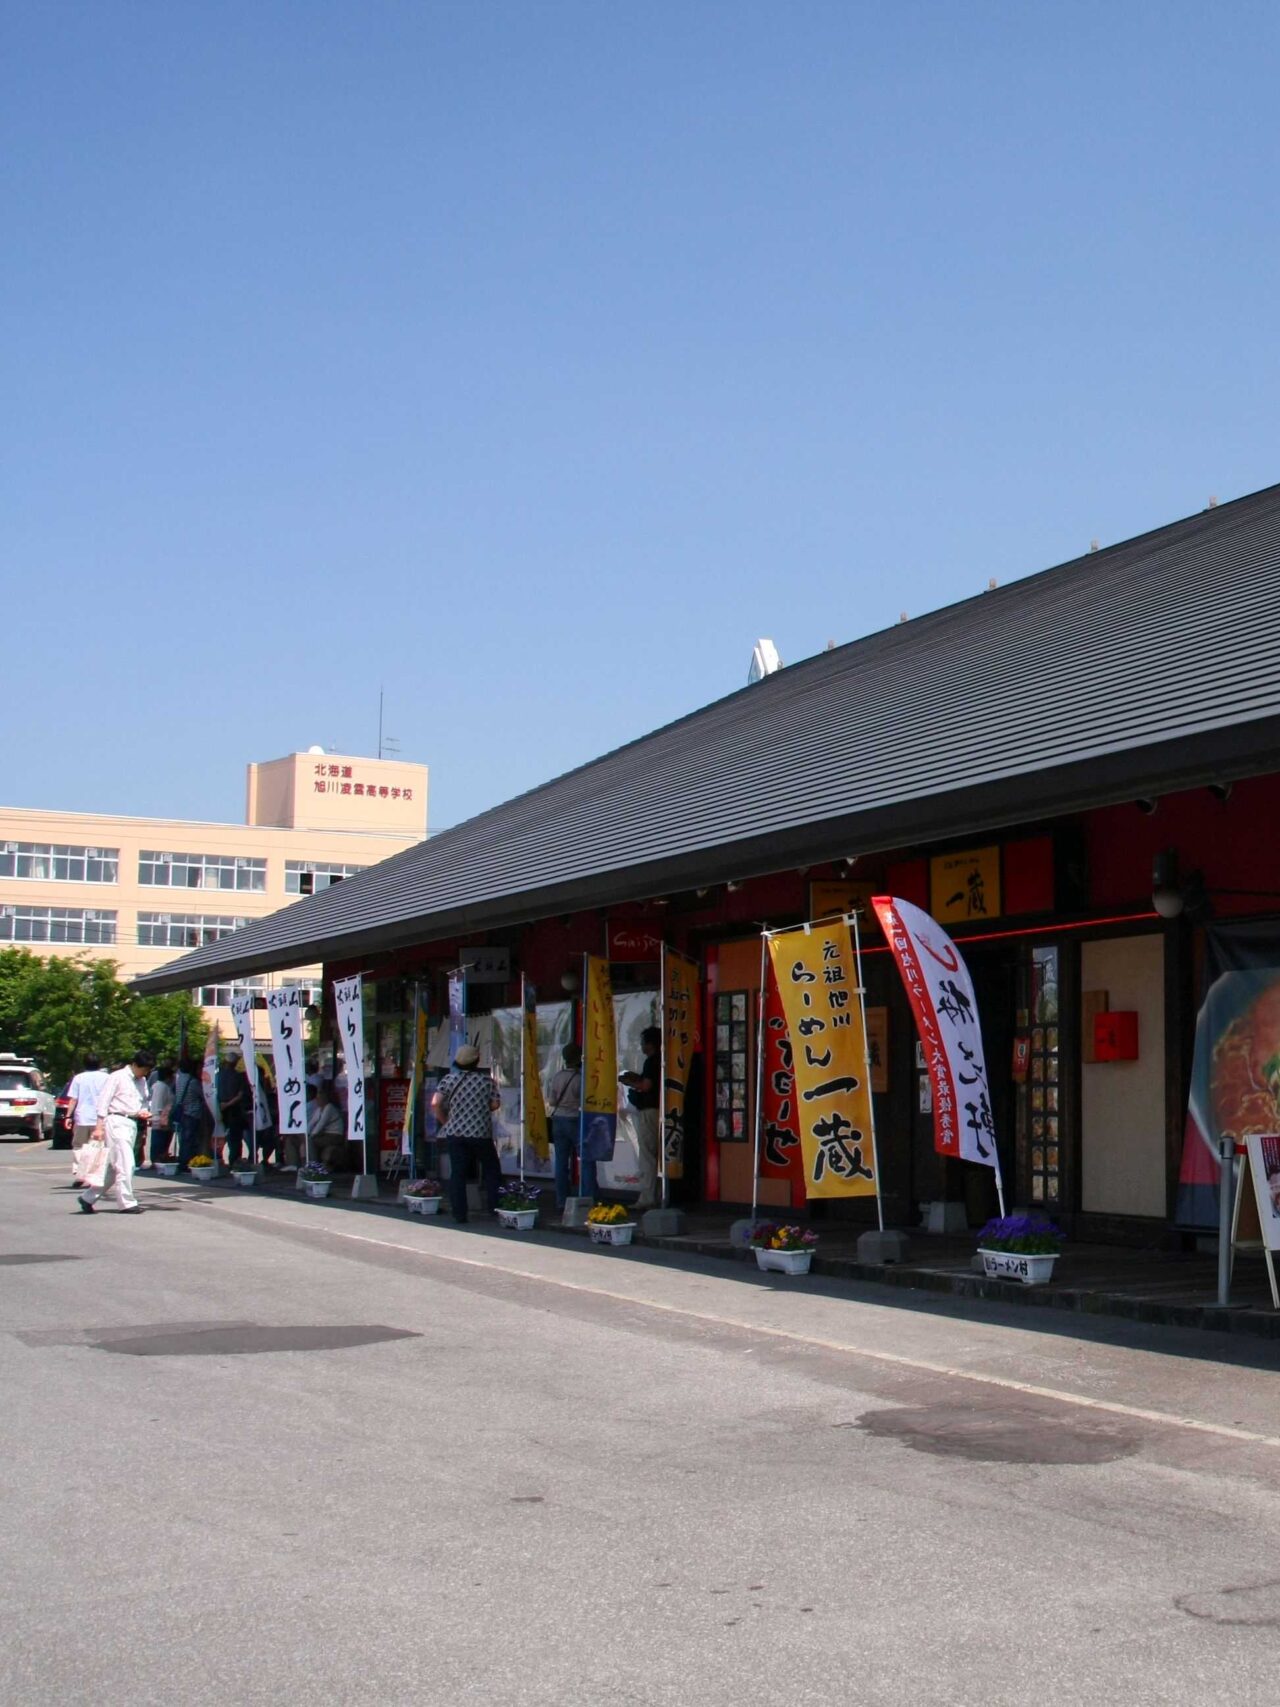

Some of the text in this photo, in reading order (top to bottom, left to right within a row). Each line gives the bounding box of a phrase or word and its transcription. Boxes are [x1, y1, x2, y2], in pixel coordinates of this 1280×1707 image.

[314, 763, 352, 778] 北海道
[791, 961, 832, 1068] らーめん
[822, 940, 850, 1028] 元祖旭川
[280, 1012, 302, 1129] らーめん
[347, 1007, 364, 1133] らーめん
[803, 1075, 875, 1187] 一蔵
